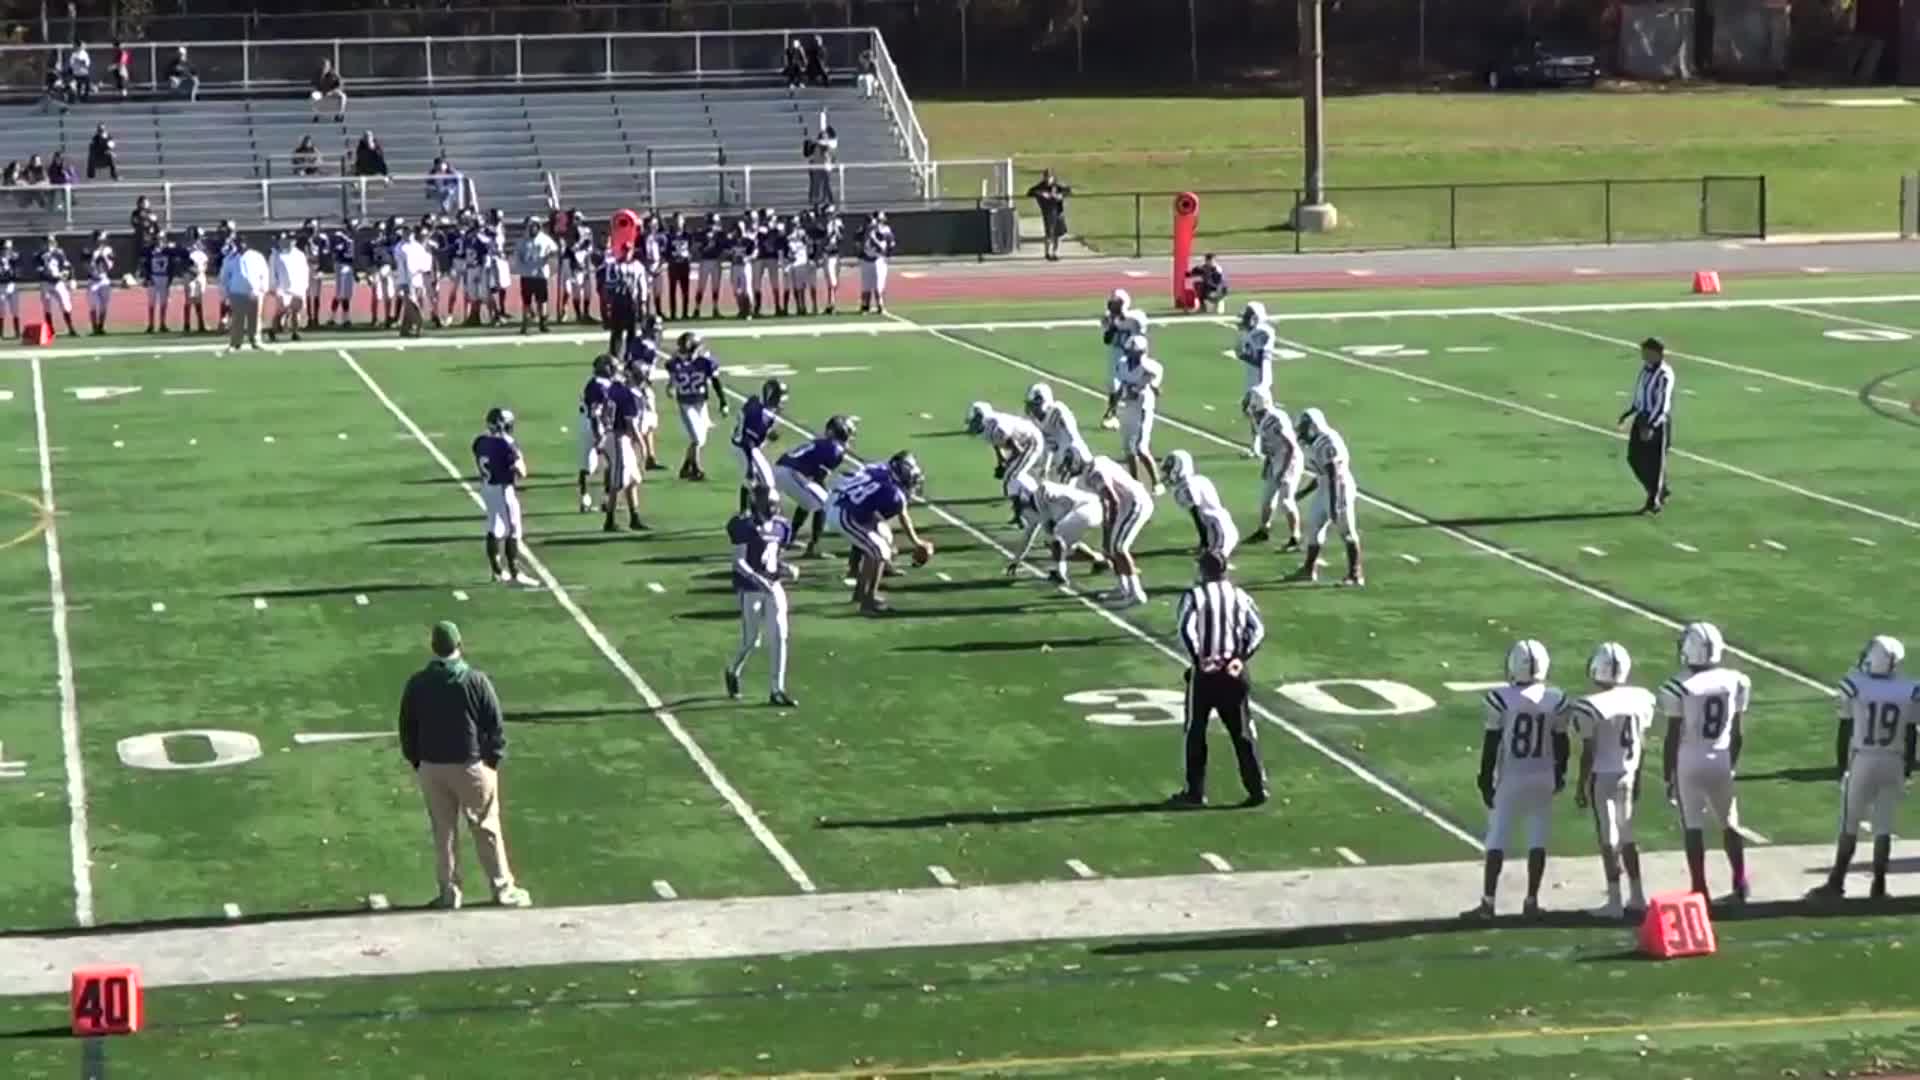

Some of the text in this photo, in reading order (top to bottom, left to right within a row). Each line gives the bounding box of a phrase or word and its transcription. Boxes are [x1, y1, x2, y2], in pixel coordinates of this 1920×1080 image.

[674, 371, 706, 395] 22
[1511, 712, 1546, 759] 81
[1619, 714, 1638, 760] 4
[1702, 696, 1726, 740] 8
[1862, 701, 1900, 746] 19
[1659, 900, 1711, 951] 30
[75, 976, 130, 1029] 40
